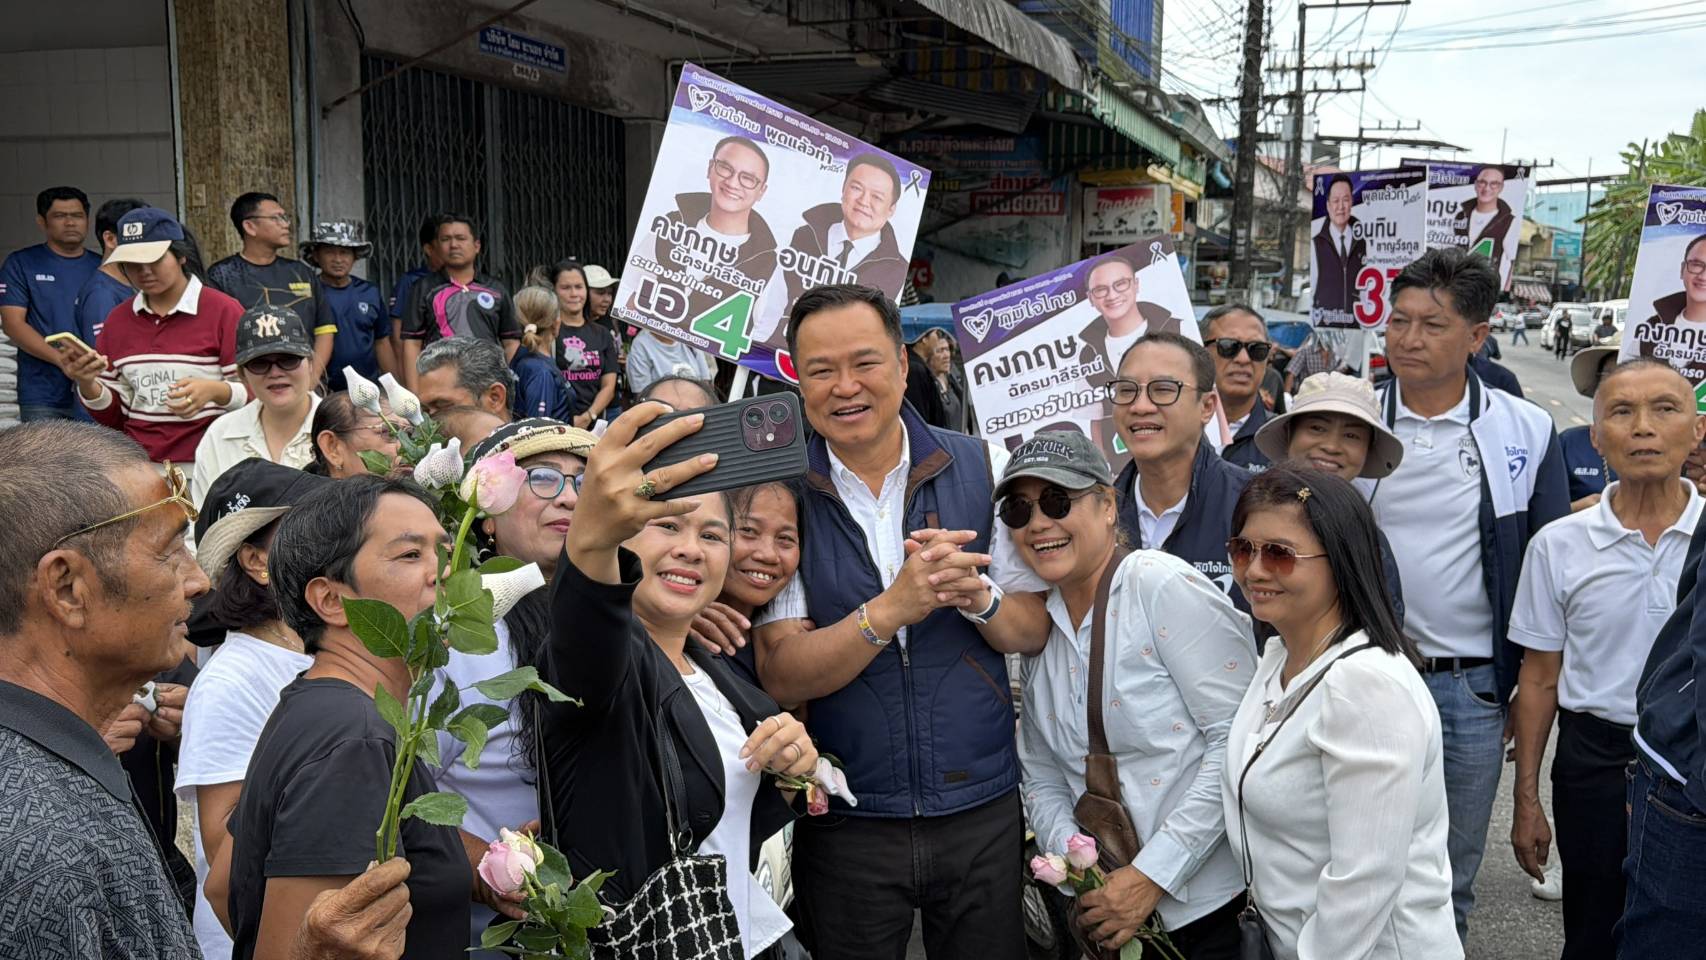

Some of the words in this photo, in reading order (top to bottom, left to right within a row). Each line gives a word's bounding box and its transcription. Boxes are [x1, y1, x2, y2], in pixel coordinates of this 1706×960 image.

[710, 102, 761, 133] ภูมิใจไทย
[765, 124, 833, 164] พูดแล้วทำ
[1362, 183, 1409, 206] พูดแล้วทำ
[650, 214, 738, 264] คงกฤษ
[1353, 217, 1397, 246] อนุทิน
[1376, 239, 1420, 254] ชาญวีรกูล
[631, 254, 723, 300] ระนองอัปเกรด
[670, 248, 767, 294] ฉัตรมาลีรัตน์
[634, 276, 689, 323] เอ
[998, 289, 1077, 330] ภูมิใจไทย
[691, 290, 755, 360] 4
[560, 369, 602, 381] Throne?
[972, 335, 1078, 386] คงกฤษ
[1007, 355, 1105, 400] ฉัตรมาลีรัตน์
